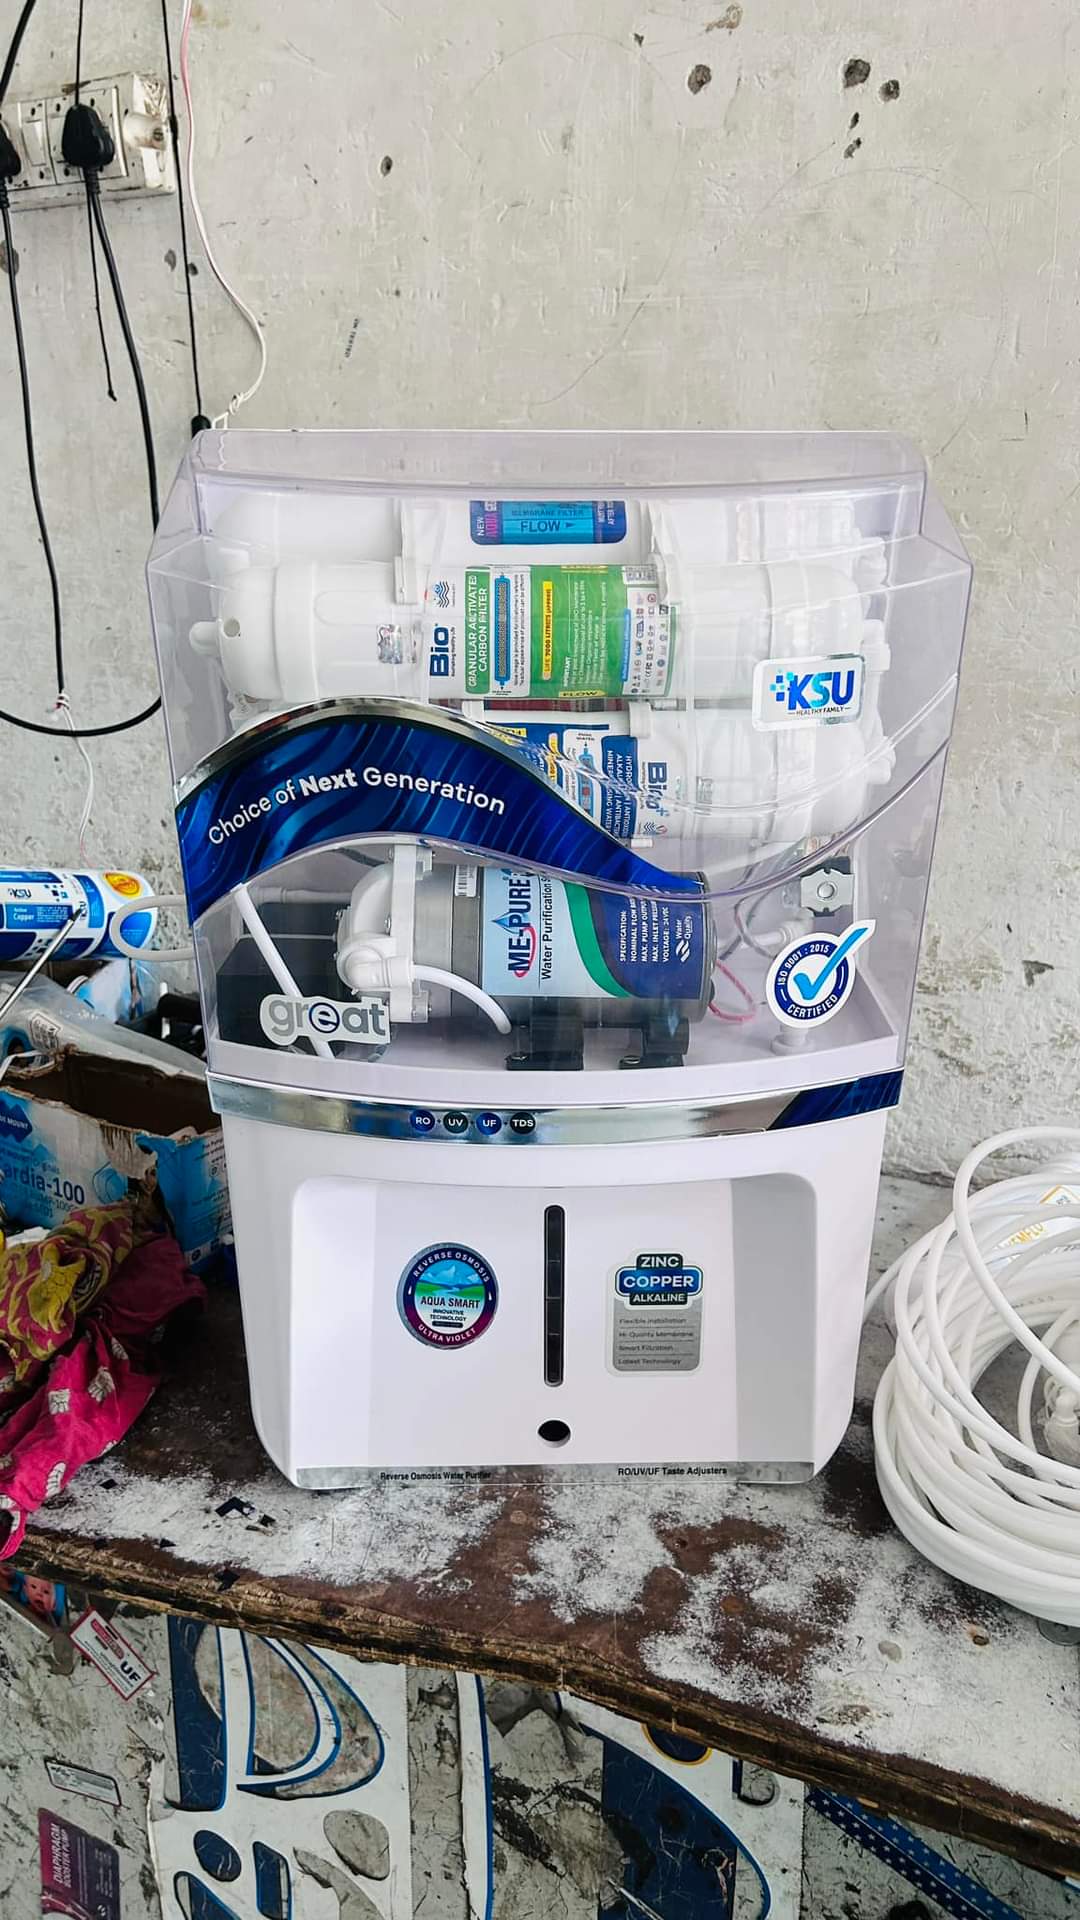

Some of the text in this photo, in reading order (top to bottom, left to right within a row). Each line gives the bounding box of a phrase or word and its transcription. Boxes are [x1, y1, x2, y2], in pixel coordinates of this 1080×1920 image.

[520, 520, 561, 533] FLOW
[468, 575, 477, 687] GRANULAR ACTIVATED
[478, 587, 487, 672] CARBON FILTER
[430, 626, 449, 676] Bio
[788, 670, 855, 711] KSU
[208, 766, 506, 845] Choice of Next Generation
[542, 884, 552, 942] Purification
[683, 915, 693, 940] Quality
[630, 927, 638, 962] NOMINAL
[662, 928, 670, 962] VOLTAGE:
[542, 947, 552, 980] Water
[778, 970, 787, 986] ISO
[784, 950, 803, 969] 9001
[809, 943, 830, 953] 2015
[268, 1000, 386, 1037] great
[786, 994, 838, 1018] CERTIFIED
[415, 1116, 534, 1127] RO UV UF TDS
[413, 1251, 490, 1283] REVERSE OSMOSIS
[640, 1256, 680, 1268] ZINC
[623, 1275, 694, 1288] COPPER
[421, 1295, 481, 1309] AQUA SMART
[432, 1308, 464, 1316] INNOVATIVE
[632, 1293, 686, 1303] ALKALINE
[430, 1314, 467, 1322] TECHNOLOGY
[418, 1324, 444, 1342] ULTRA
[446, 1328, 477, 1343] VIOLET
[380, 1471, 491, 1480] Reverse Osmosis Water Purifier
[617, 1467, 728, 1477] RO/UV/UF Taste Adjusters
[120, 1661, 141, 1682] UF
[50, 1822, 63, 1884] DIAPHRAGM
[61, 1828, 72, 1889] BOOSTER PUMP
